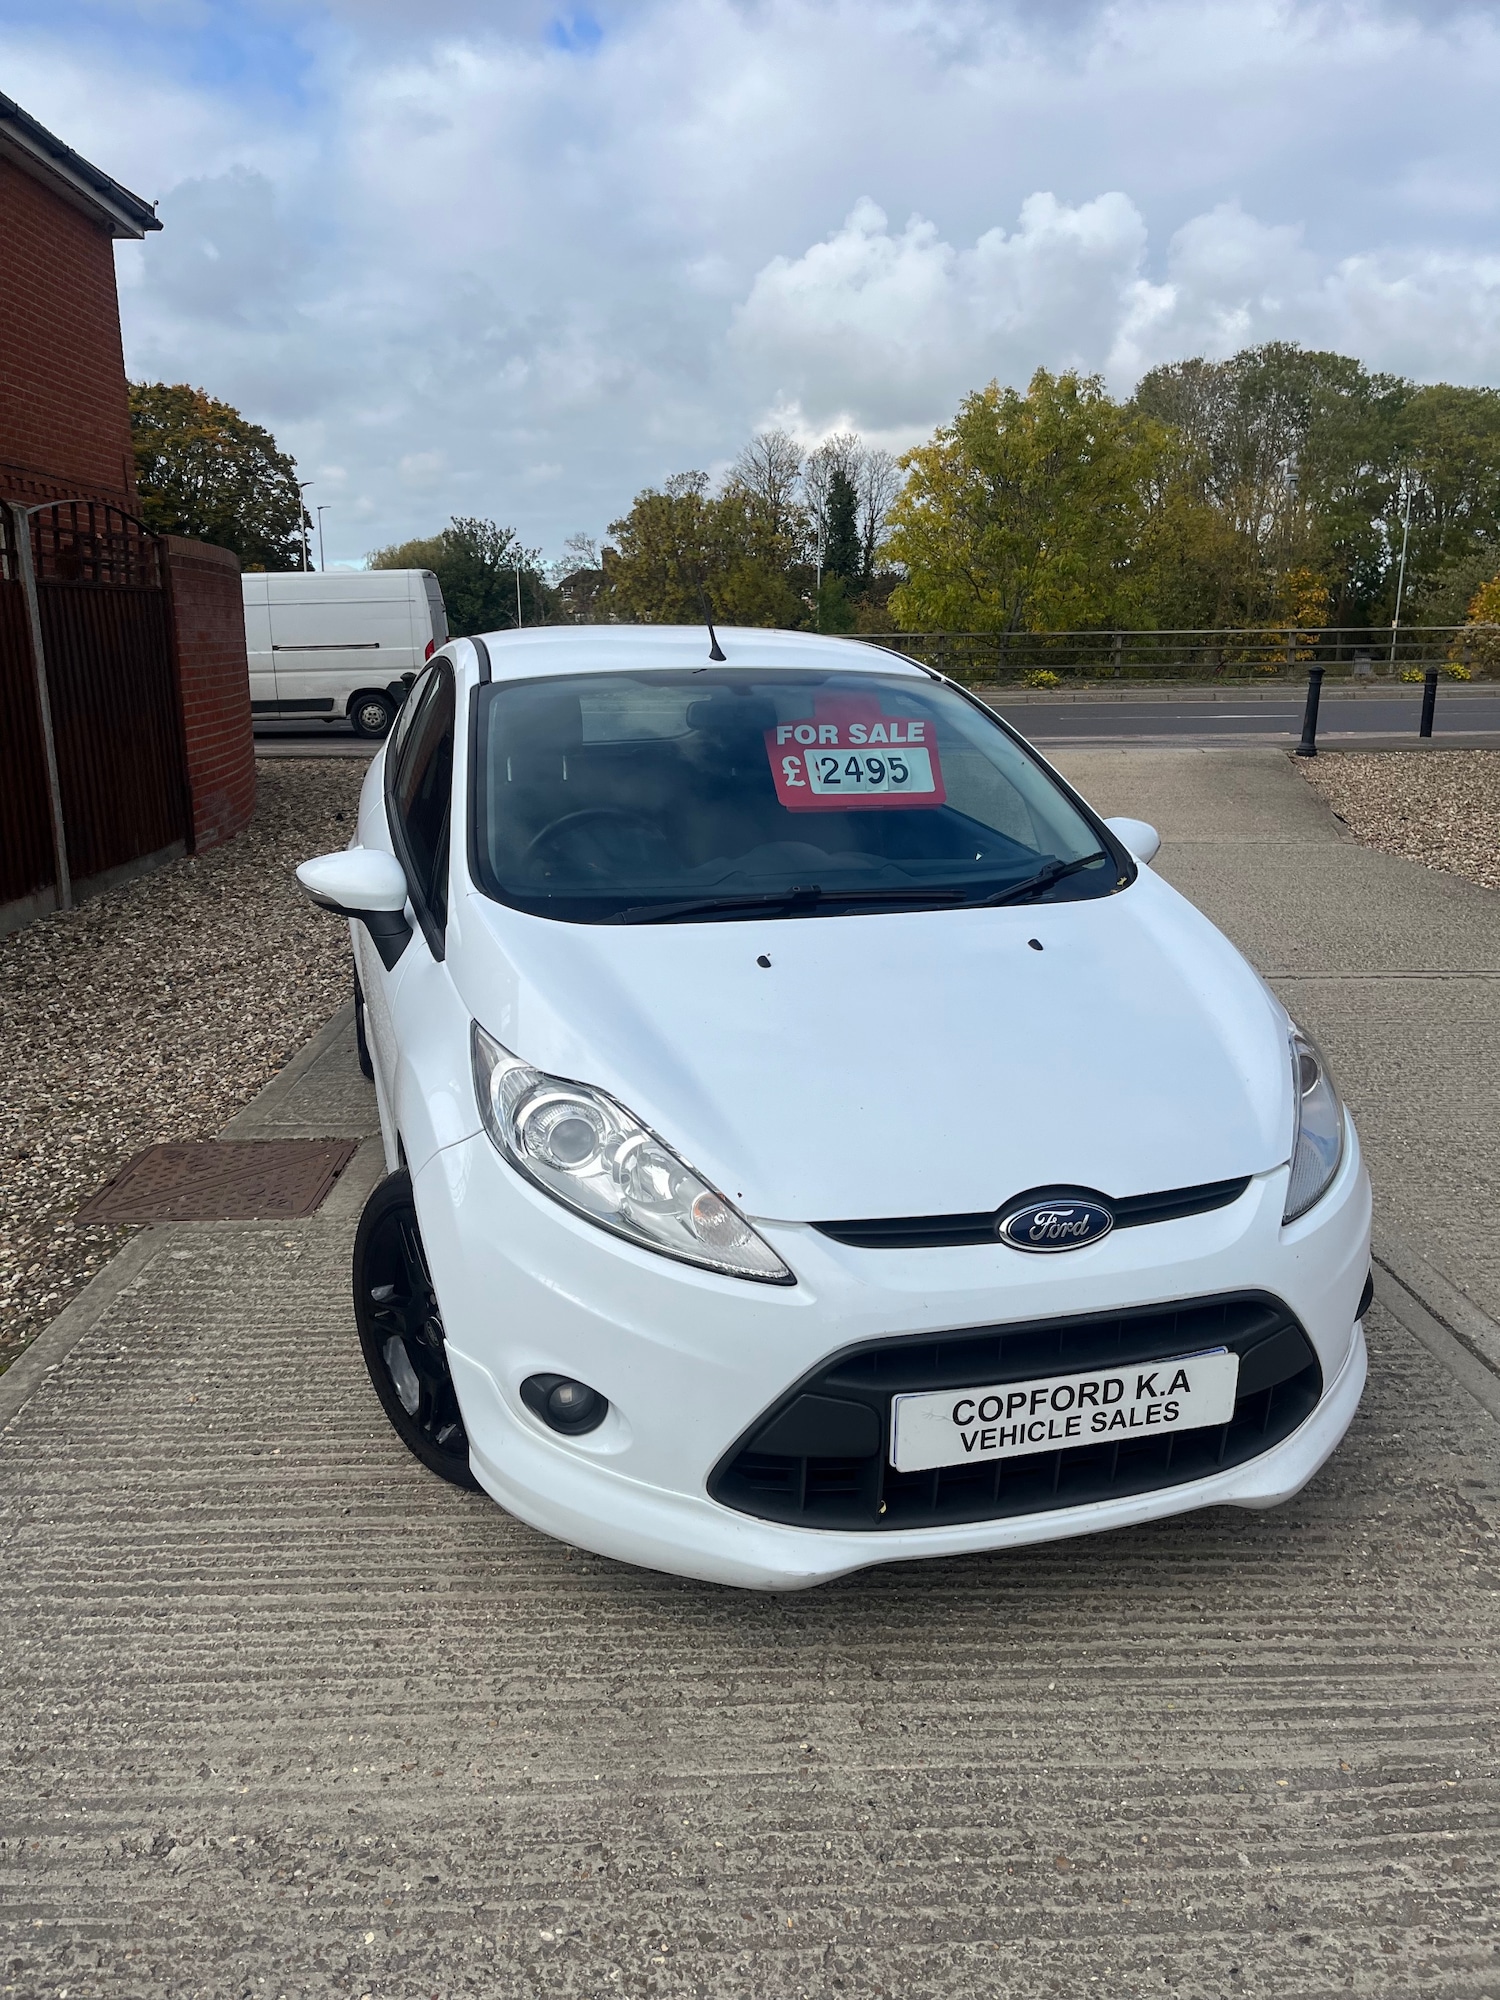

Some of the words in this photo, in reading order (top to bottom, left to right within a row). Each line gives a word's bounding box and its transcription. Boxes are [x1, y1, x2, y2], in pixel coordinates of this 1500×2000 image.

[776, 724, 839, 746] FOR
[848, 721, 925, 744] SALE
[820, 756, 909, 784] 2495
[1028, 1209, 1091, 1241] Ford
[952, 1378, 1125, 1426] COPFORD
[1135, 1369, 1191, 1400] K.A
[960, 1414, 1082, 1452] VEHICLE
[1090, 1401, 1180, 1433] SALES
